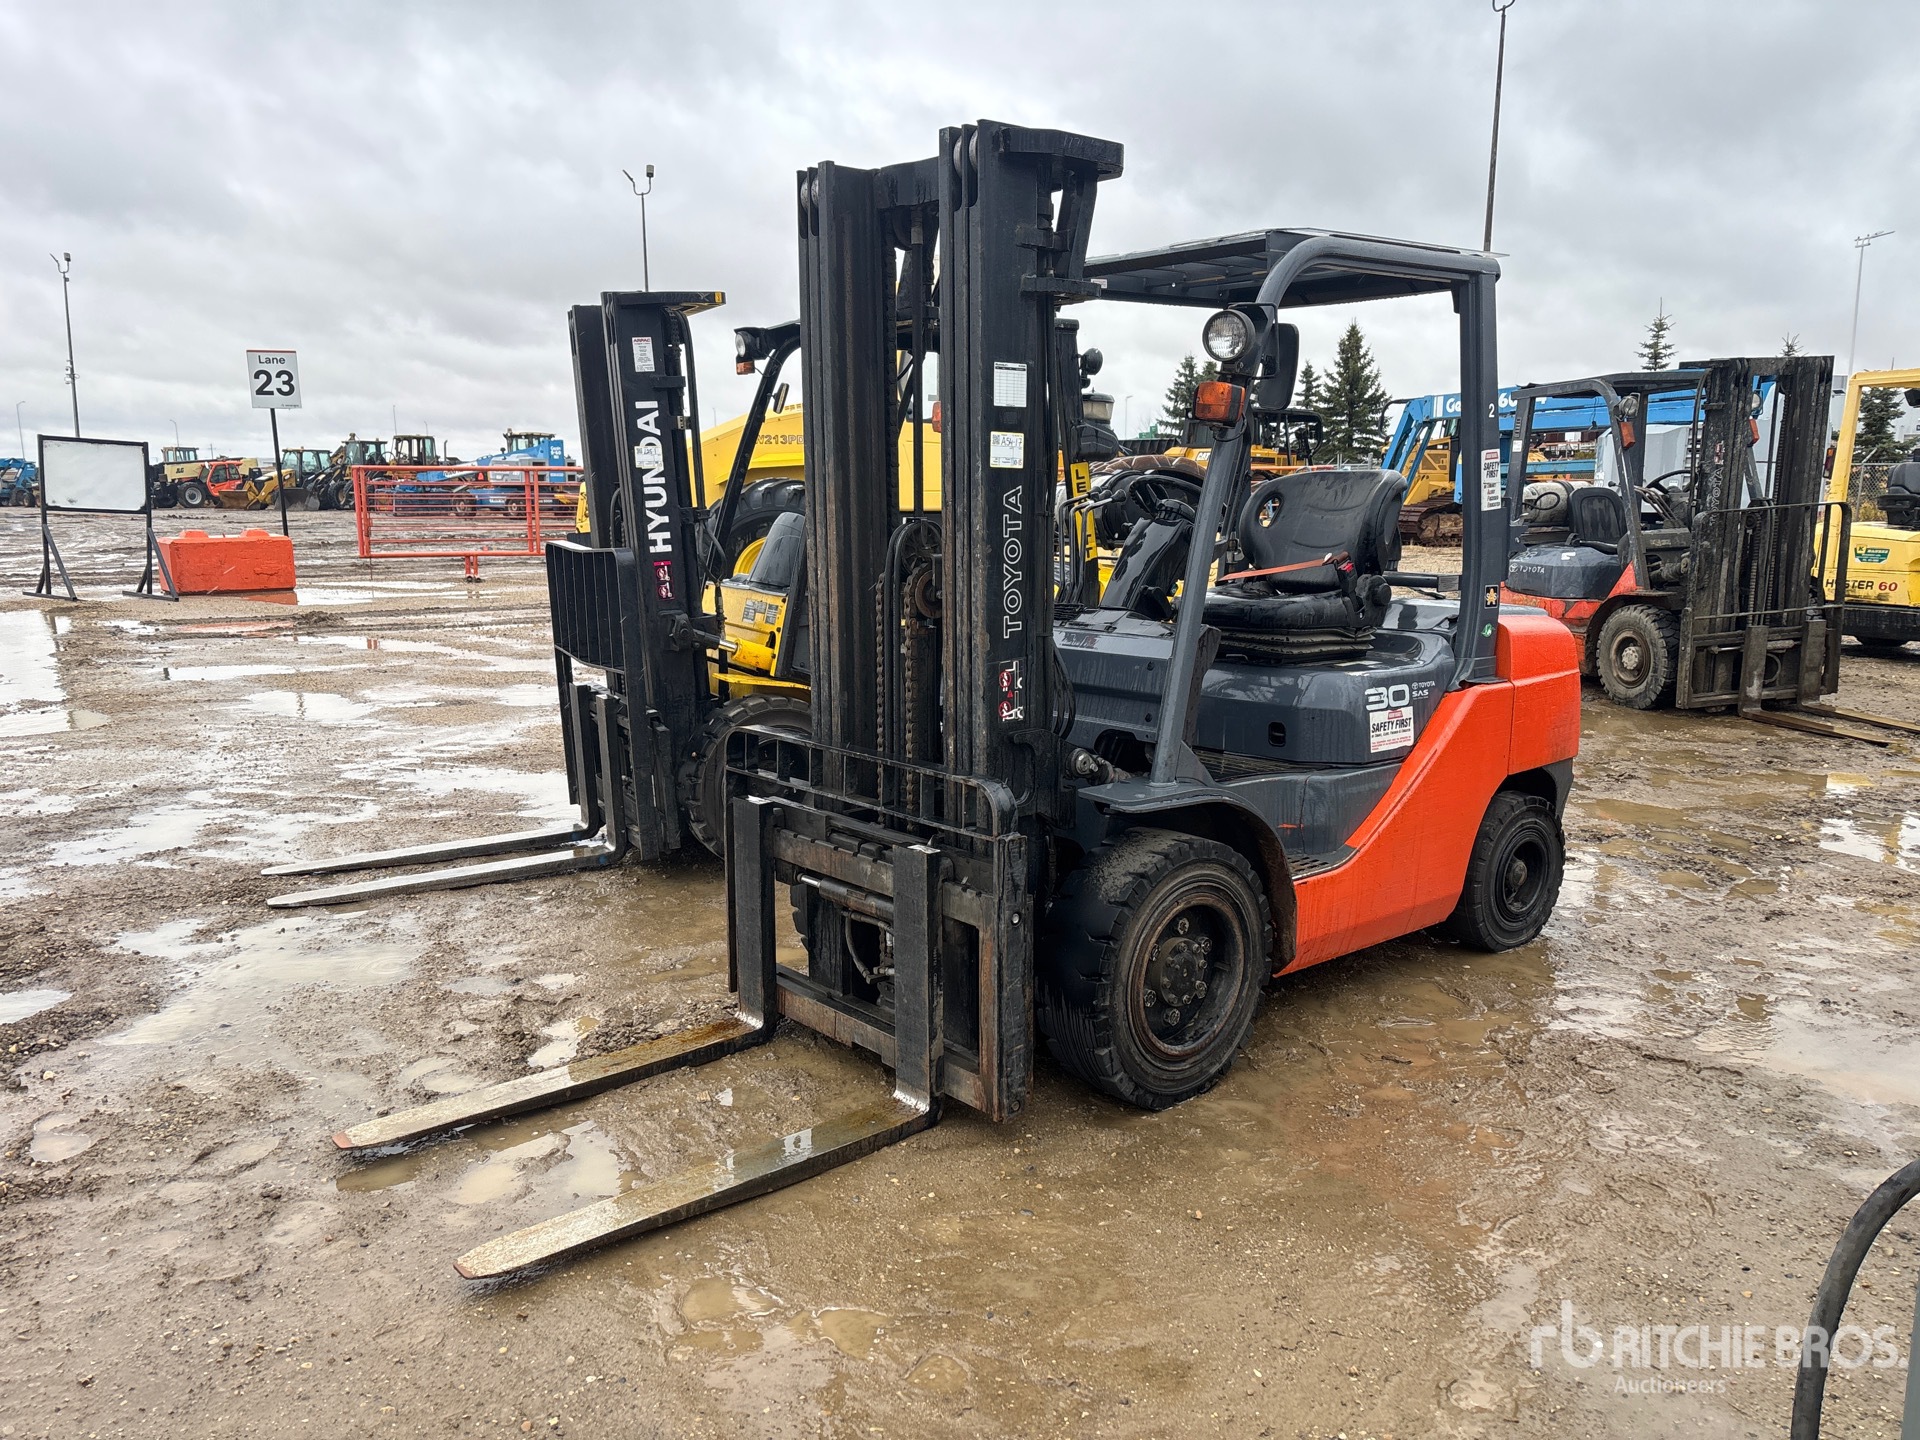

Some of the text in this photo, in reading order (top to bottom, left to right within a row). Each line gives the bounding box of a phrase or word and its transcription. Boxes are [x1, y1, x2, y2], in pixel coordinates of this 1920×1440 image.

[258, 355, 286, 364] Lane
[253, 369, 295, 396] 23
[1488, 403, 1495, 418] 2
[1483, 461, 1500, 471] SAFETY
[1486, 470, 1499, 478] FIRST
[1003, 485, 1023, 639] TOYOTA
[1825, 579, 1899, 592] HSTER 60
[1364, 680, 1436, 711] 30 TOYOTA
[1412, 689, 1429, 698] SAS
[1371, 720, 1395, 734] SAFETY
[1395, 717, 1412, 730] FIRST
